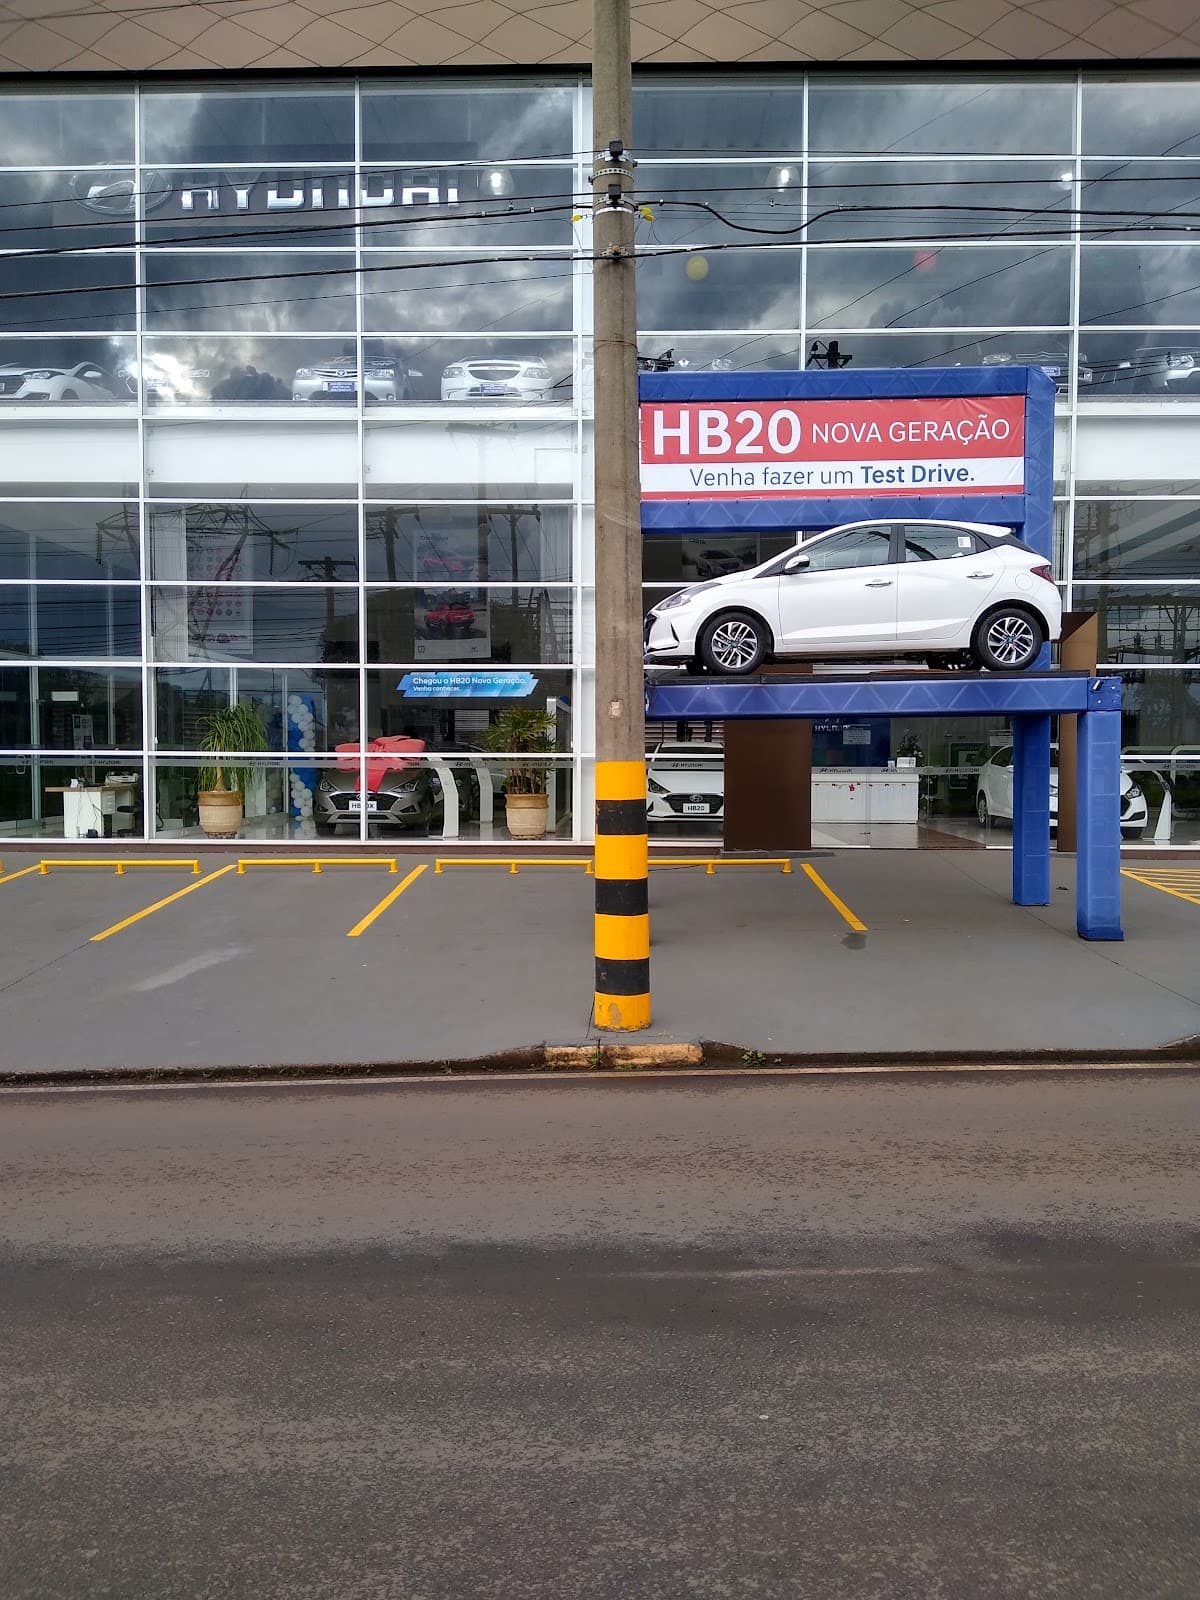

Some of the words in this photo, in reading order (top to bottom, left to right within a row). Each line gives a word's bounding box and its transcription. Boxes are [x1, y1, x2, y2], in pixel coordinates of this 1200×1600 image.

[652, 408, 801, 456] HB20
[811, 421, 883, 444] NOVA
[888, 414, 1011, 446] GERAÇÃO
[689, 467, 755, 488] Venha
[762, 465, 814, 486] fazer
[820, 468, 853, 485] um
[860, 465, 906, 485] Test
[911, 463, 976, 484] Drive.
[412, 677, 443, 685] Chegou
